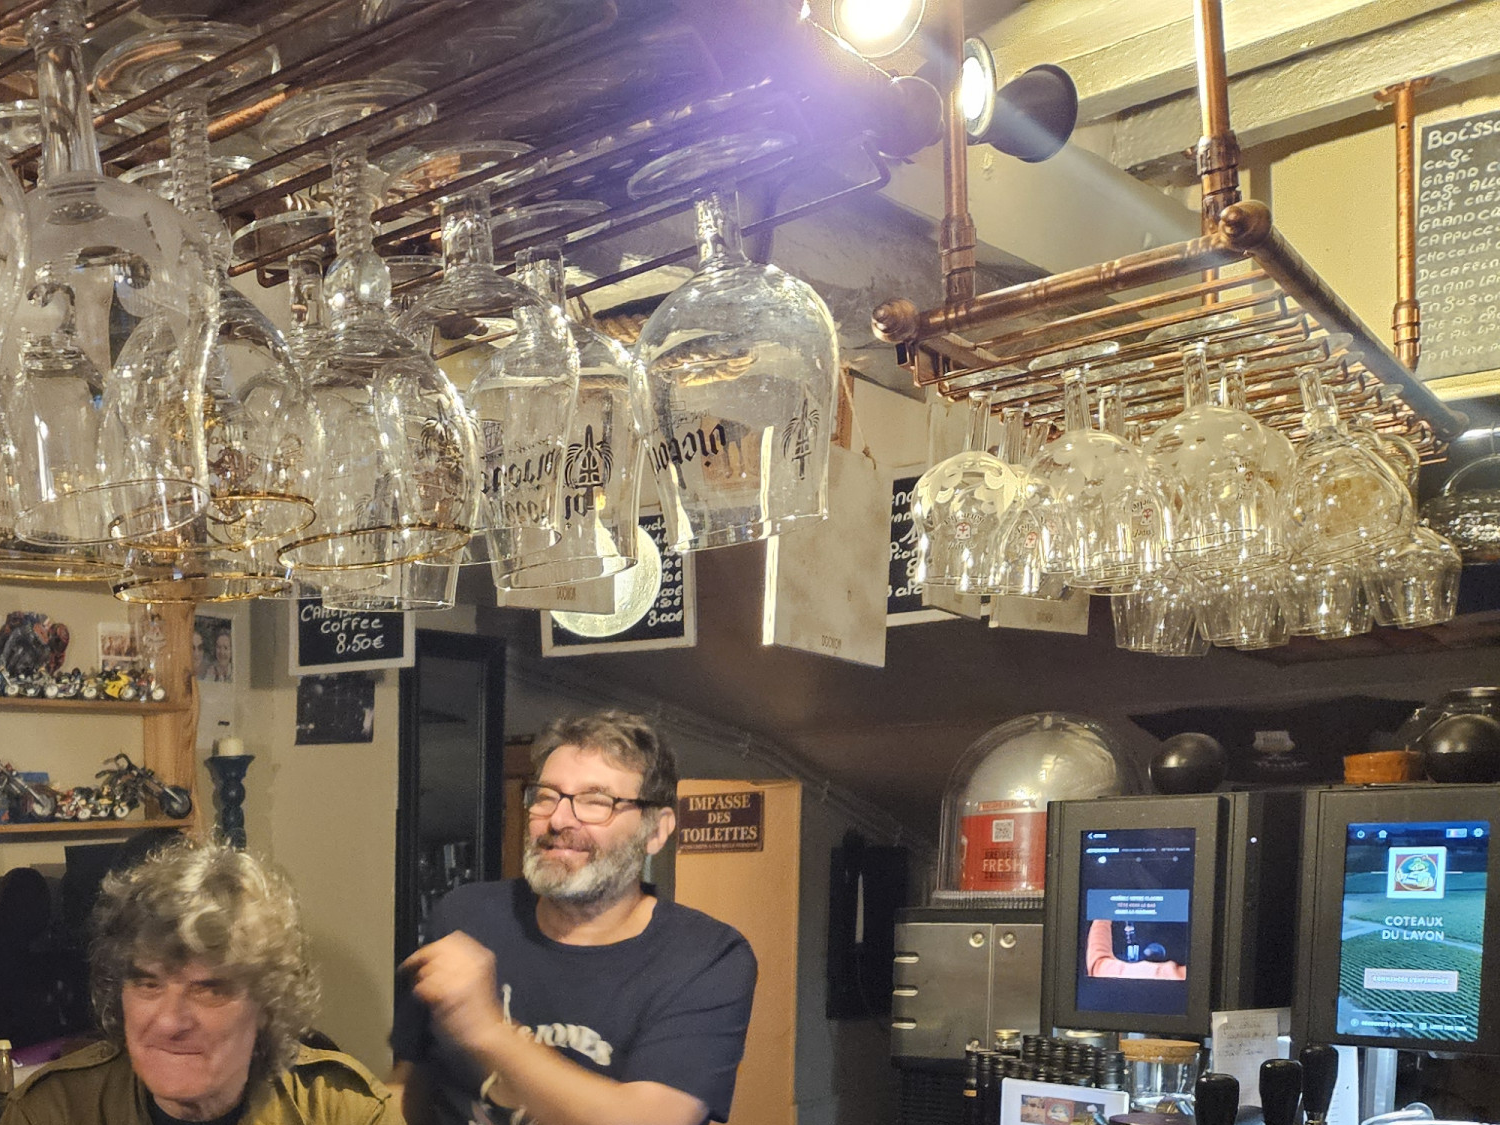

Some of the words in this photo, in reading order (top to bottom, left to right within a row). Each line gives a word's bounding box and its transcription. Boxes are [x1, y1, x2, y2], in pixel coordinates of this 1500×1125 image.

[688, 794, 751, 811] IMPASSE
[707, 812, 731, 824] DES
[681, 825, 758, 843] TOILETTES
[982, 858, 1023, 873] FRESH
[1385, 916, 1443, 927] COTEAUX
[1382, 929, 1400, 940] DU
[1403, 930, 1445, 941] LAYON
